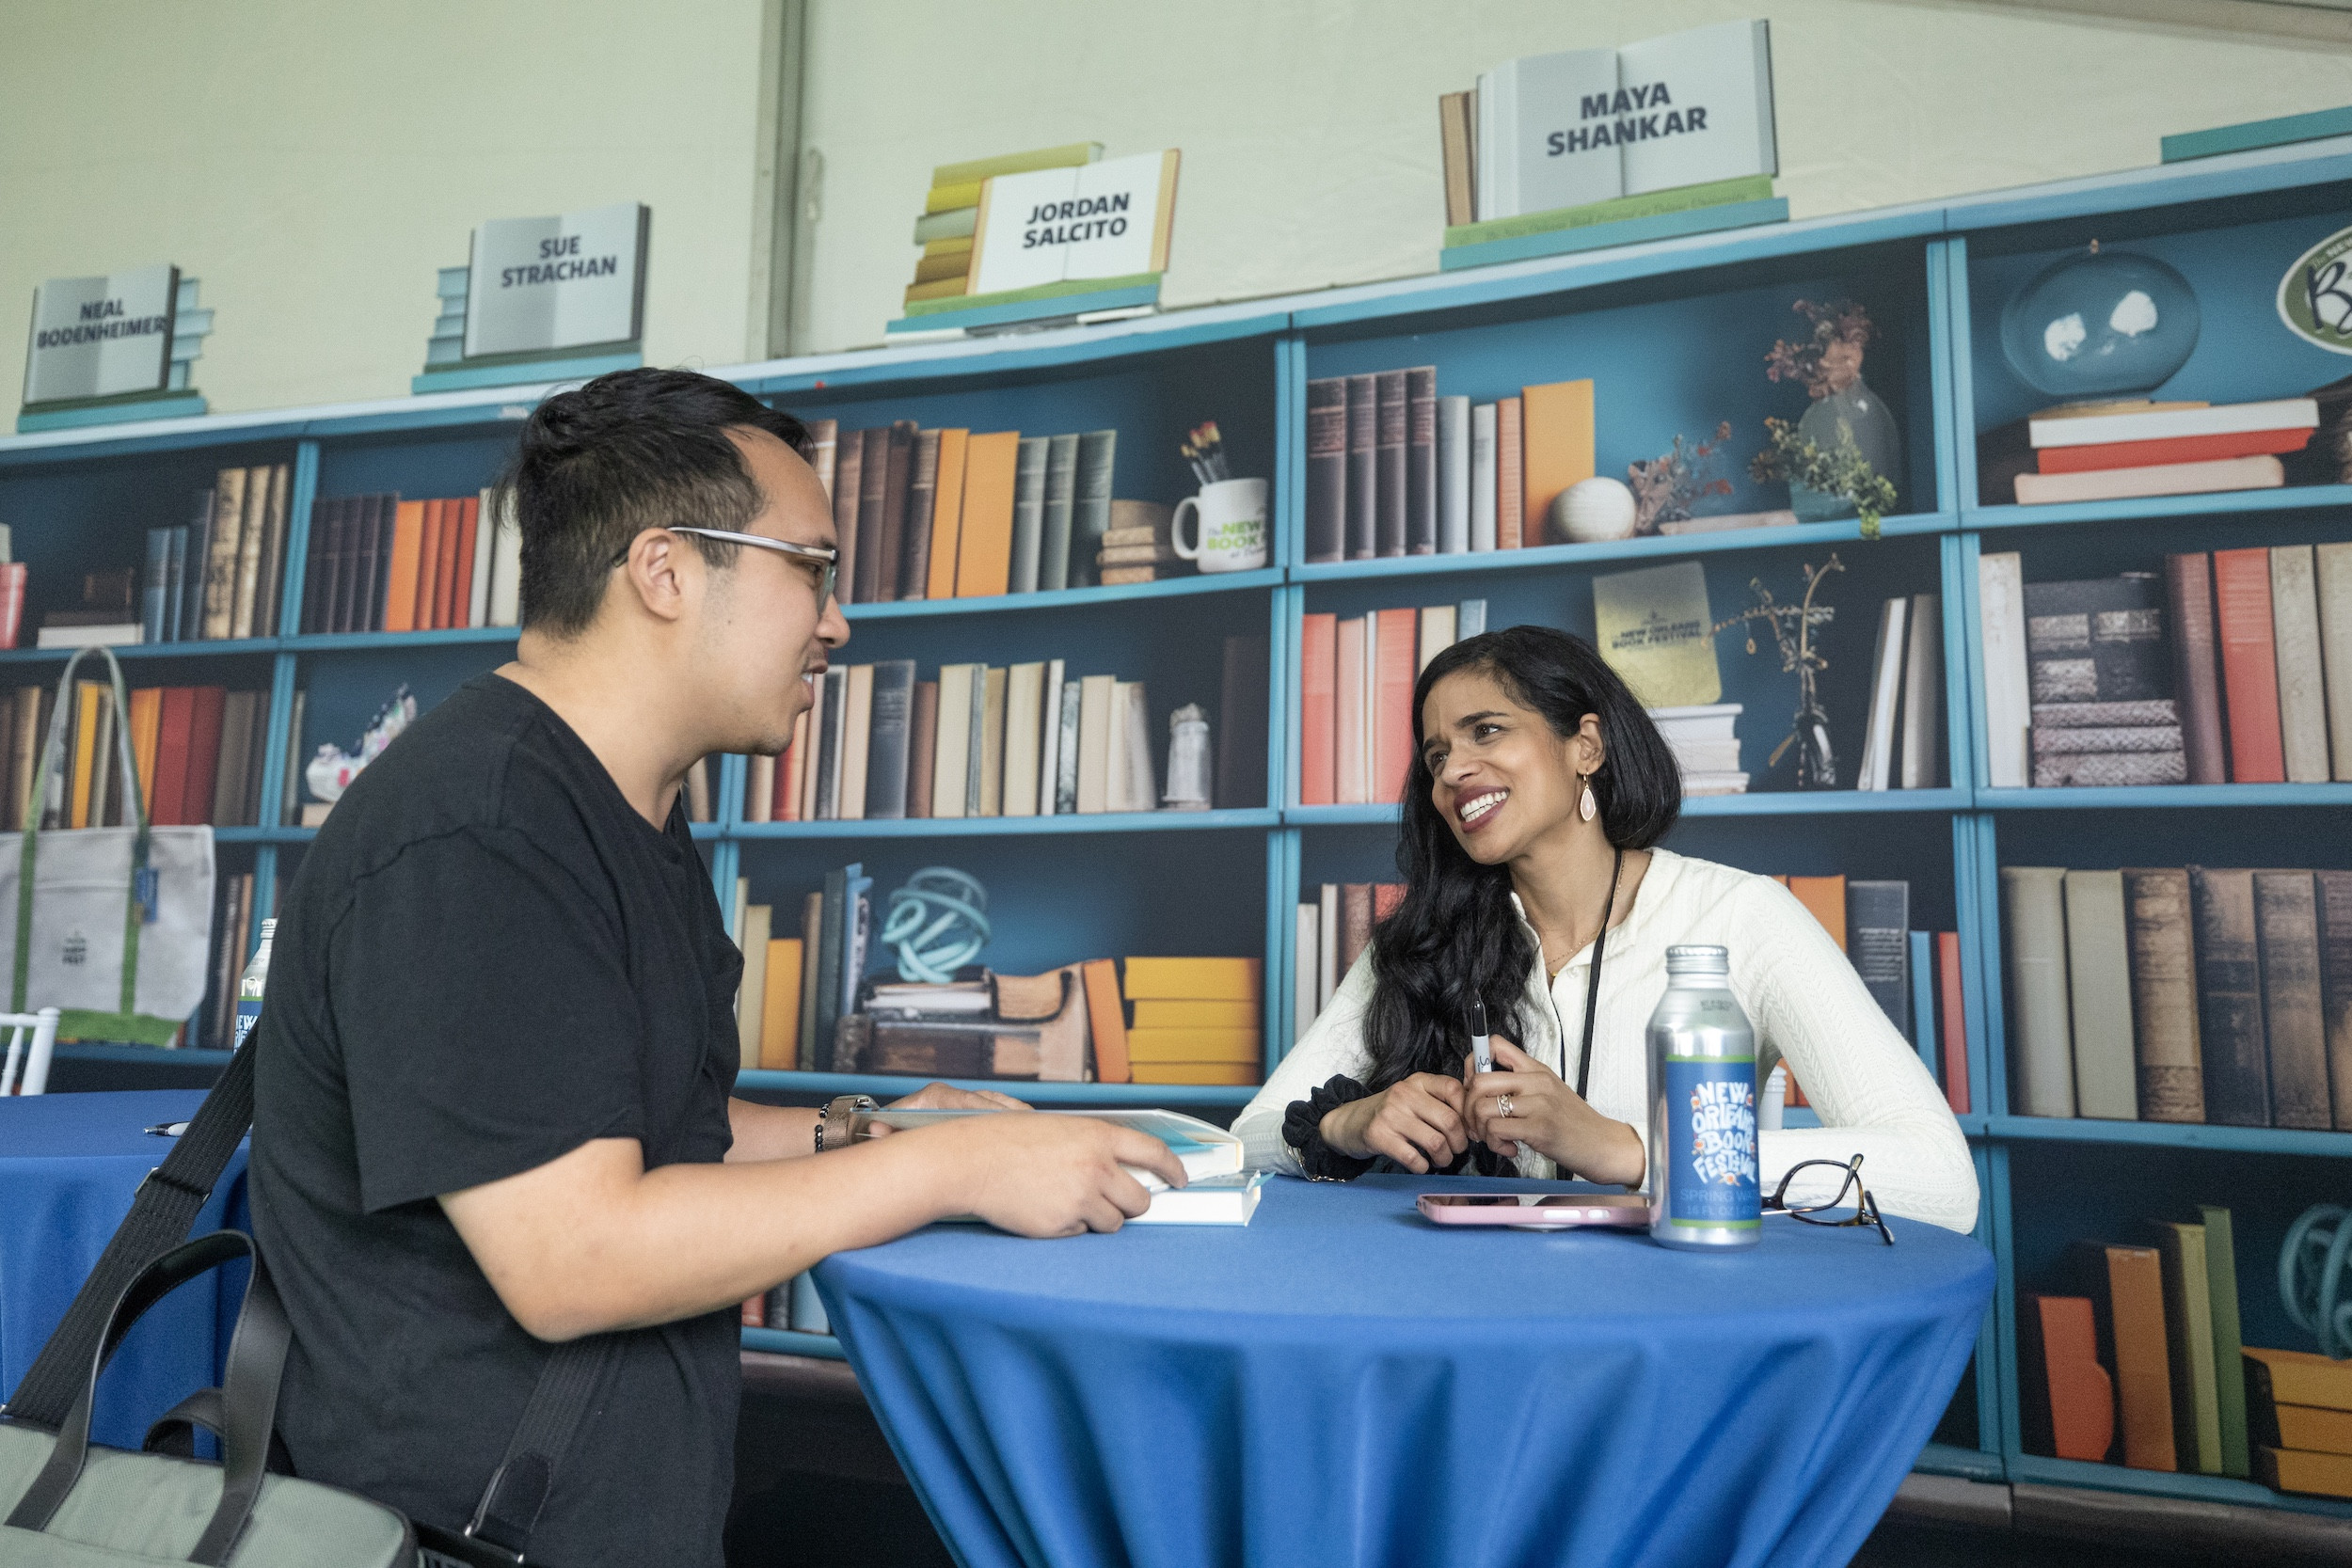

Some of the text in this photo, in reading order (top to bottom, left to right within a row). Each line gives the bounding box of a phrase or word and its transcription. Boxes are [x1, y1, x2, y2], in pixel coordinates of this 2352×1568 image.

[1581, 82, 1671, 119] MAYA
[1548, 106, 1708, 156] SHANKAR
[1026, 193, 1129, 225] JORDAN
[1023, 217, 1127, 248] SALCITO
[540, 235, 580, 259] SUE
[502, 255, 617, 288] STRACHAN
[80, 298, 124, 321] NEAL
[37, 315, 168, 349] BODENHEIMER
[1222, 520, 1261, 534] NEW
[1207, 536, 1257, 549] BOOK
[1696, 1081, 1748, 1106] NEW
[1697, 1130, 1754, 1156] BOOK
[1679, 1188, 1735, 1203] SPRING
